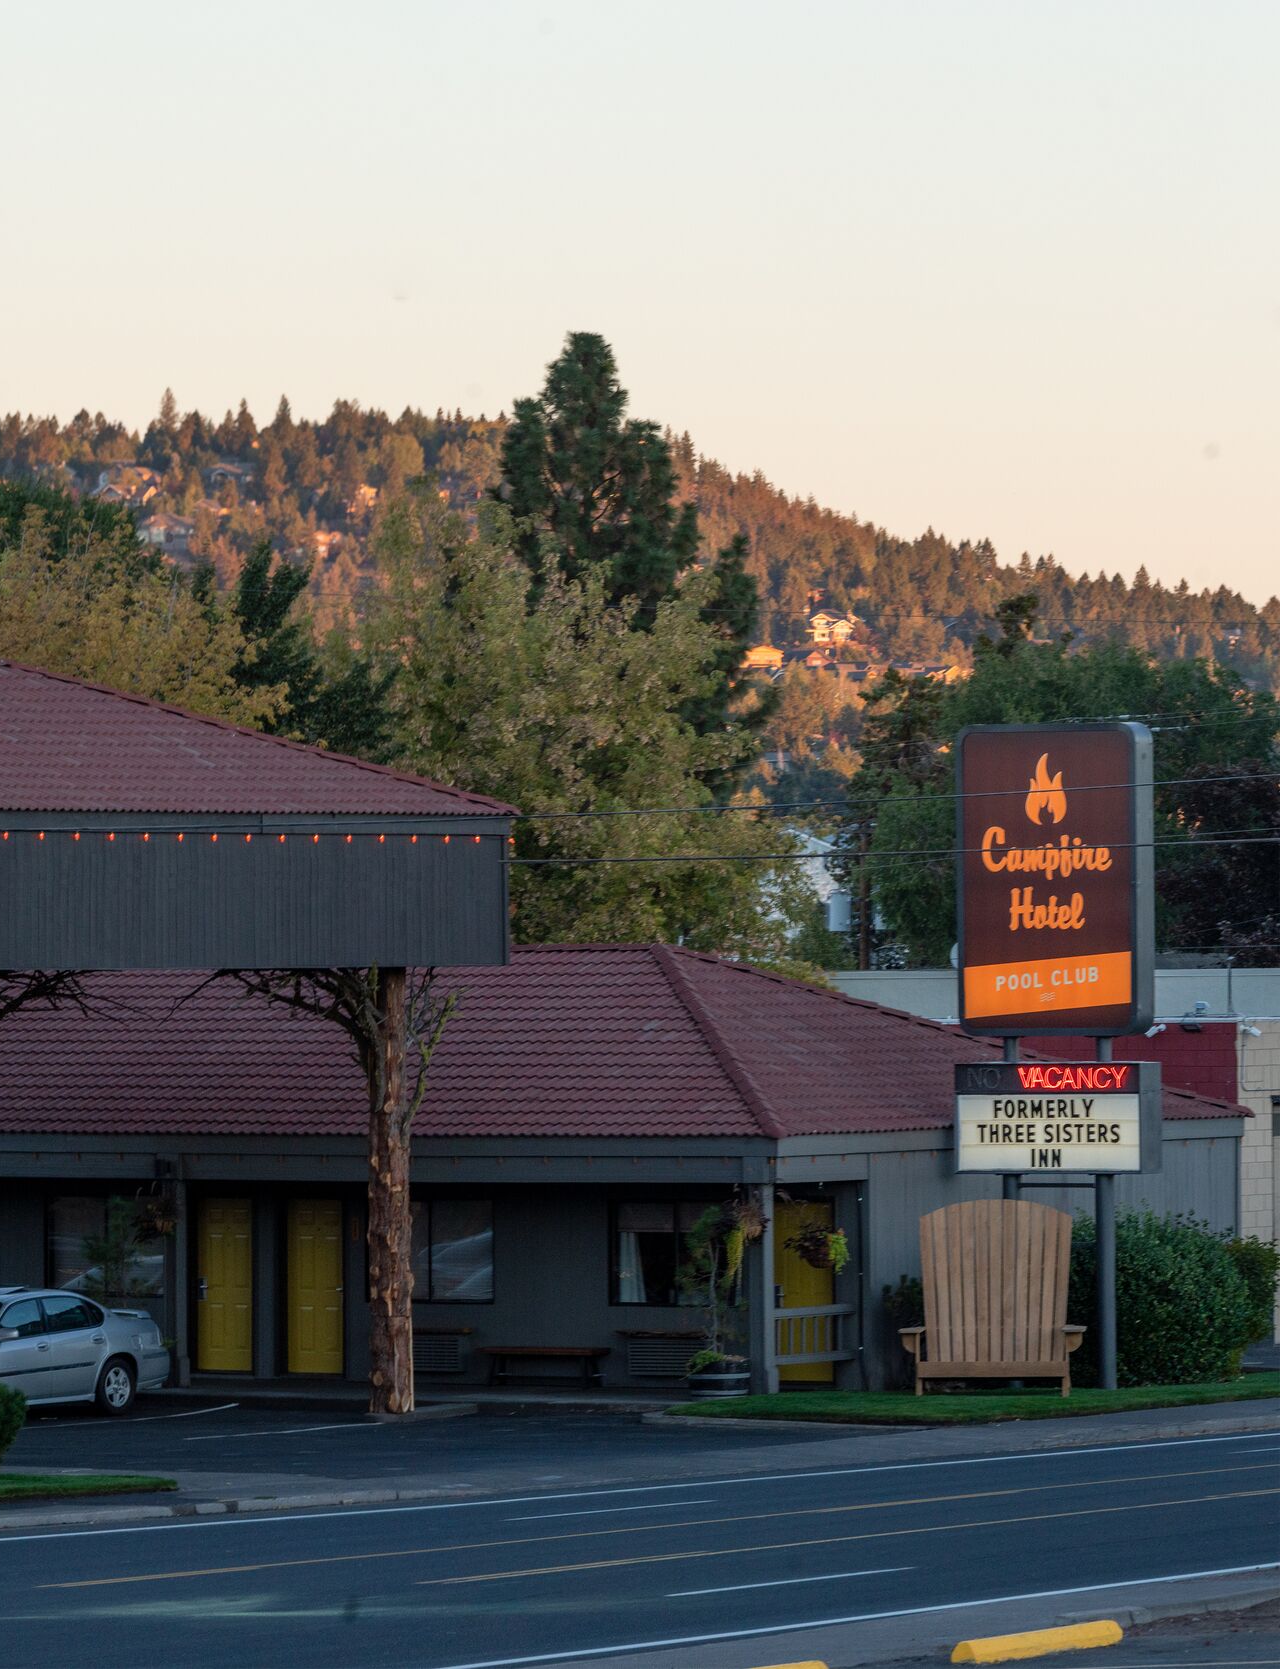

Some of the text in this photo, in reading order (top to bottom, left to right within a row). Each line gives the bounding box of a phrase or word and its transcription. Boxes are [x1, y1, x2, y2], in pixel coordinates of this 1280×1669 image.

[981, 826, 1112, 880] Campfire
[1009, 886, 1086, 931] Hotel
[995, 966, 1099, 991] POOL CLUB
[967, 1065, 1128, 1090] NO VACANCY
[993, 1099, 1095, 1119] FORMERLY
[976, 1123, 1121, 1143] THREE SISTERS
[1031, 1149, 1062, 1168] INN
